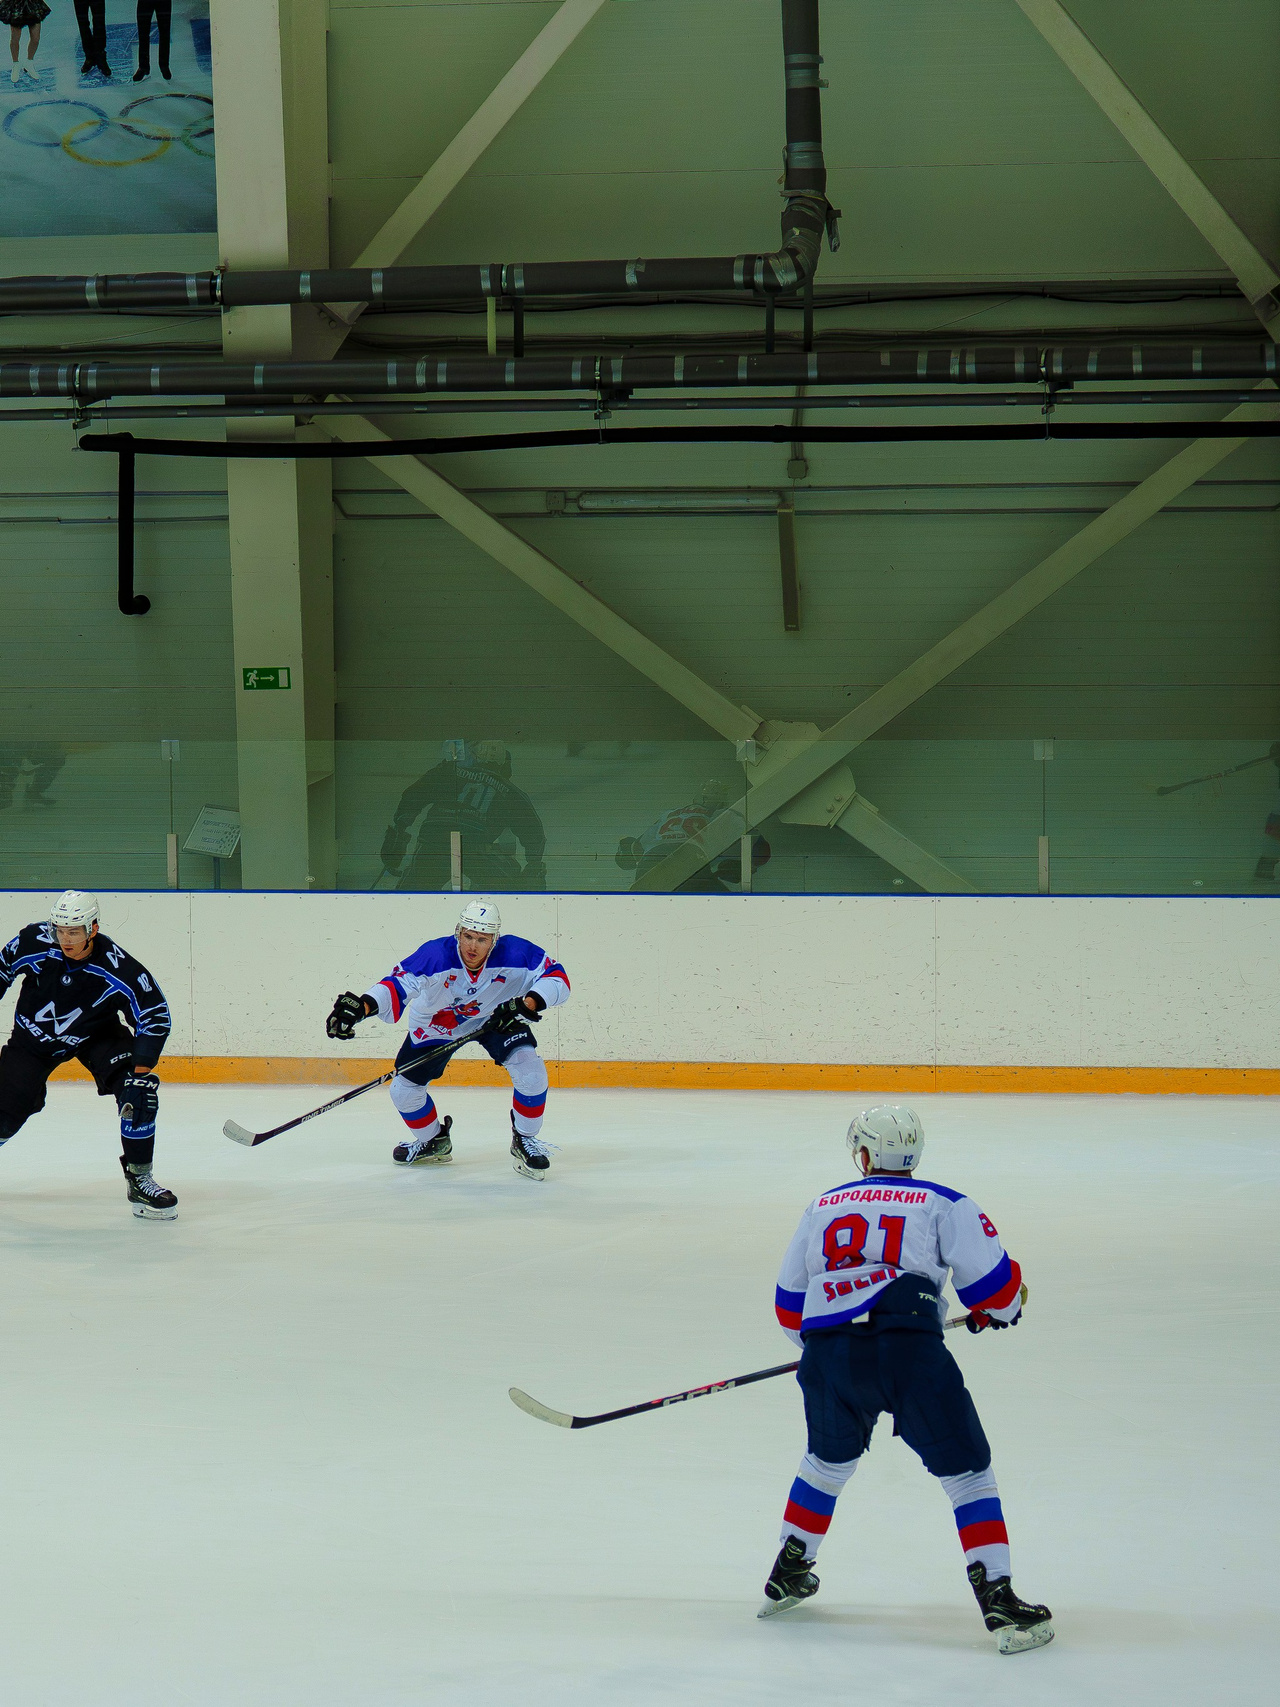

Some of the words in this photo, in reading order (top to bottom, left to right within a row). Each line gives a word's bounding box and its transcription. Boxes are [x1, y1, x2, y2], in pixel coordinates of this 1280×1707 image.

[479, 908, 487, 917] 7
[503, 1032, 528, 1048] CCM
[123, 1078, 158, 1095] CCM
[902, 1154, 914, 1167] 12
[818, 1189, 927, 1207] БОРОДАВКИН
[822, 1213, 906, 1272] 81
[662, 1380, 736, 1407] CCM
